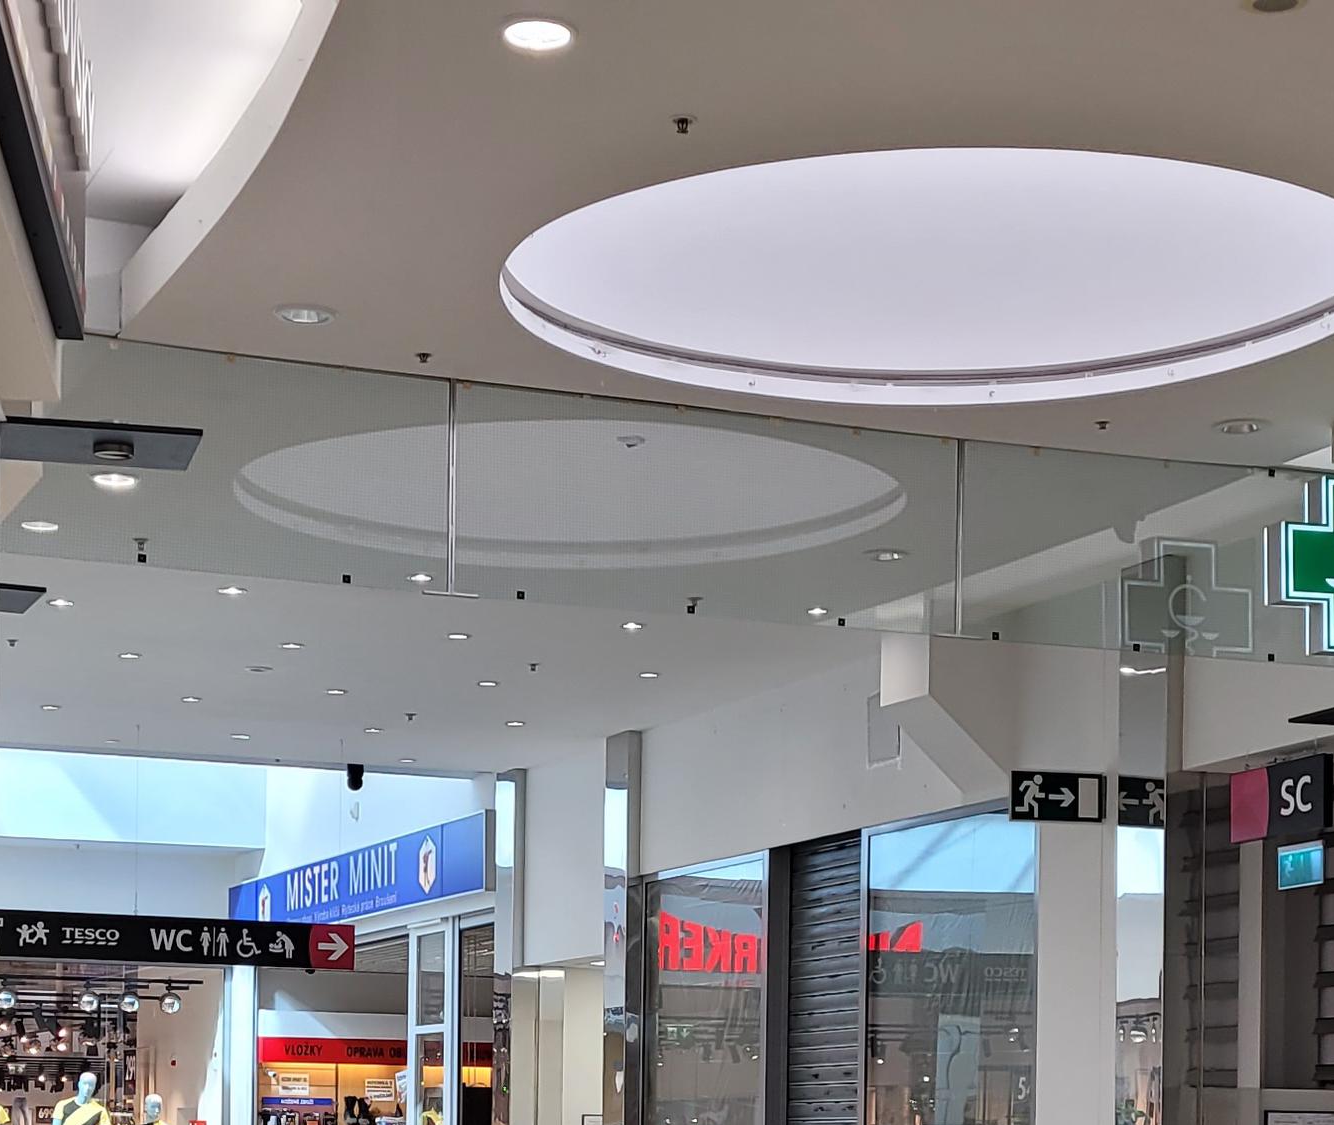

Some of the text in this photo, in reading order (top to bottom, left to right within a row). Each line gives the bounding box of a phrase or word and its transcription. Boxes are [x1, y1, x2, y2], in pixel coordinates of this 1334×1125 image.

[1280, 775, 1313, 818] SC
[286, 842, 398, 913] MISTER MINIT
[61, 927, 193, 952] TESCO WC
[284, 1043, 323, 1056] VLOŽKY
[346, 1046, 385, 1058] OPRAVA
